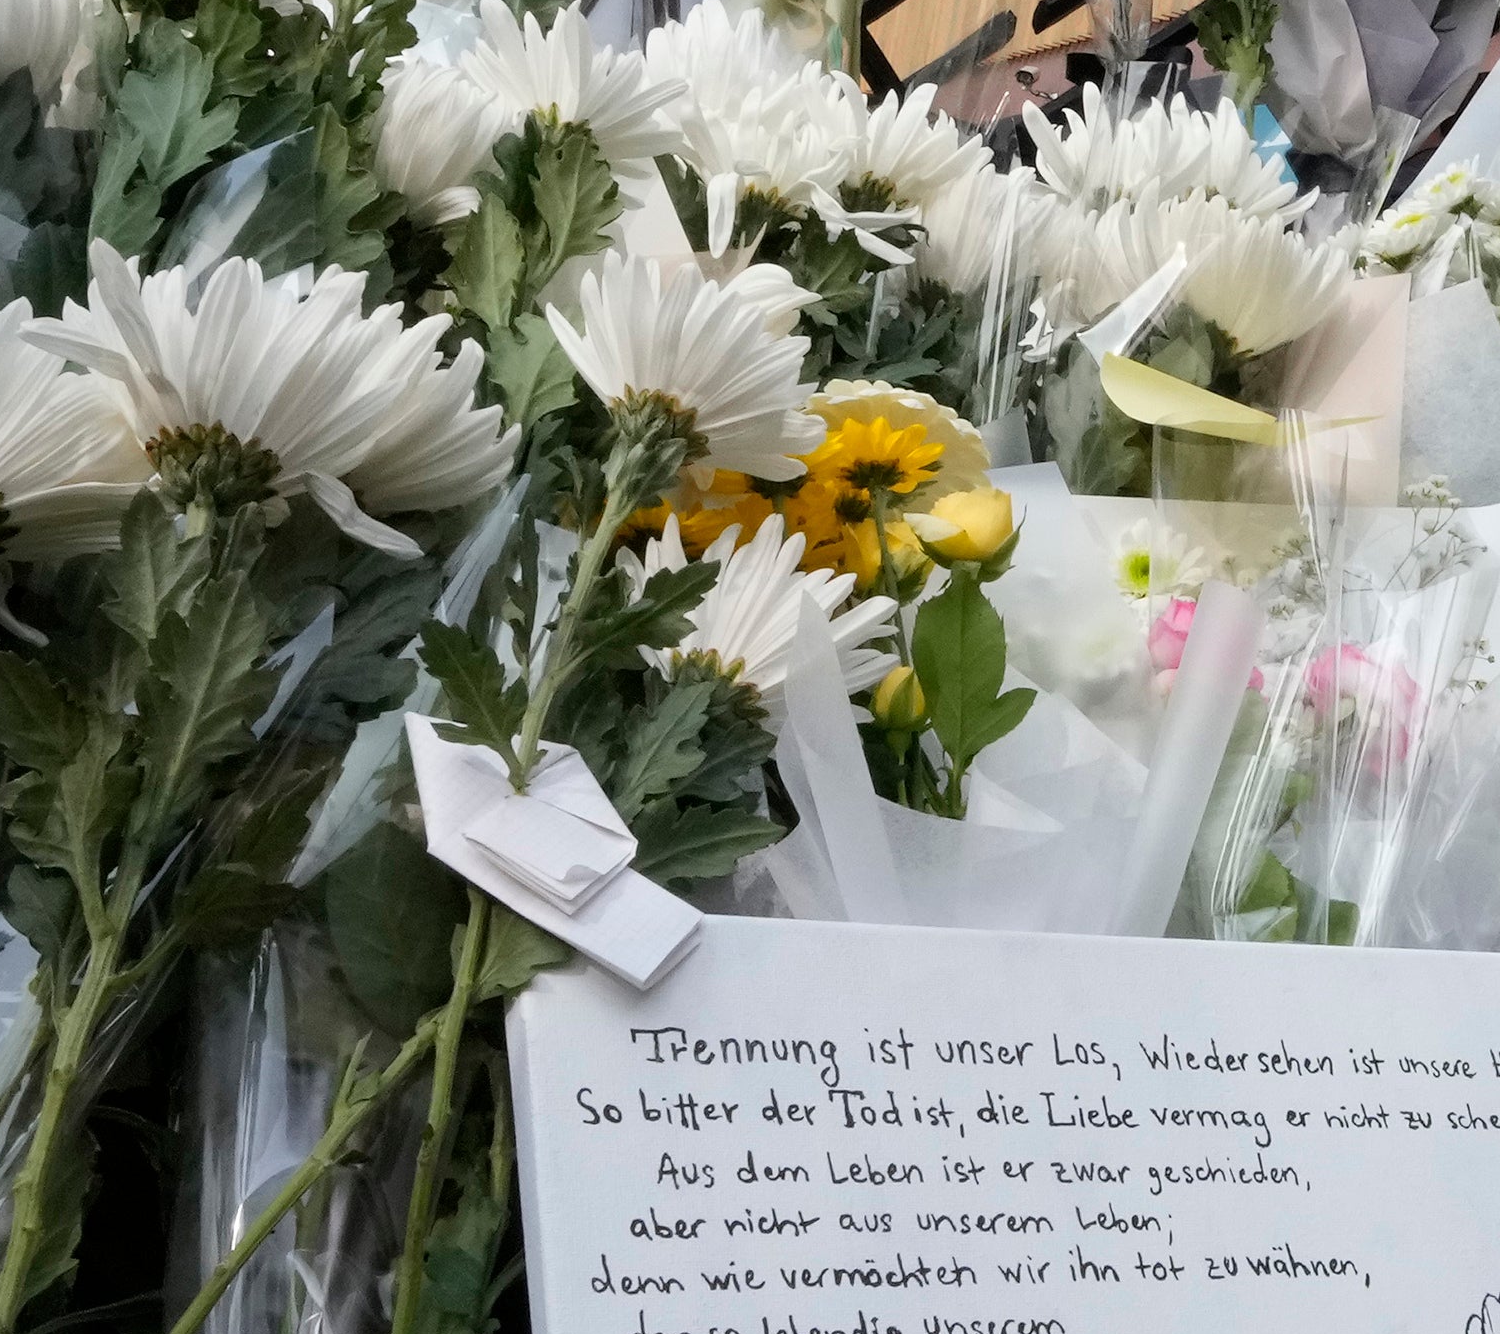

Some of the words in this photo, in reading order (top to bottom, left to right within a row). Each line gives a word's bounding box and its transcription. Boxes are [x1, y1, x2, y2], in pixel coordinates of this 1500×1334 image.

[630, 1027, 840, 1088] Trennung
[864, 1028, 914, 1070] ist
[935, 1040, 1033, 1066] unser
[1053, 1033, 1121, 1081] Los,
[1349, 1048, 1385, 1075] ist
[1399, 1056, 1476, 1079] unsere
[576, 1088, 622, 1125] So
[639, 1088, 739, 1131] bitter
[762, 1088, 816, 1126] der
[828, 1089, 903, 1128] Tod
[913, 1096, 964, 1138] ist,
[977, 1089, 1029, 1125] die
[1039, 1092, 1140, 1128] Liebe
[1150, 1108, 1271, 1148] vermag
[1286, 1110, 1310, 1127] er
[1324, 1103, 1389, 1129] nicht
[1400, 1111, 1432, 1130] zu
[657, 1152, 715, 1190] Aus
[737, 1150, 809, 1183] dem
[827, 1152, 924, 1185] Leben
[942, 1156, 985, 1185] ist
[1003, 1161, 1034, 1182] er
[1050, 1162, 1130, 1184] zwar
[1149, 1153, 1310, 1196] geschieden,
[630, 1207, 706, 1241] aber
[724, 1208, 820, 1237] nicht
[839, 1213, 892, 1233] aus
[917, 1213, 1054, 1234] unserem
[1075, 1202, 1173, 1246] Leben;
[591, 1254, 685, 1295] denn
[701, 1261, 765, 1293] wie
[780, 1253, 977, 1289] vermöchten
[998, 1255, 1050, 1284] wir
[1069, 1244, 1120, 1282] ihn
[1135, 1252, 1185, 1281] tot
[1205, 1257, 1238, 1280] zu
[1246, 1243, 1370, 1288] wähnen,
